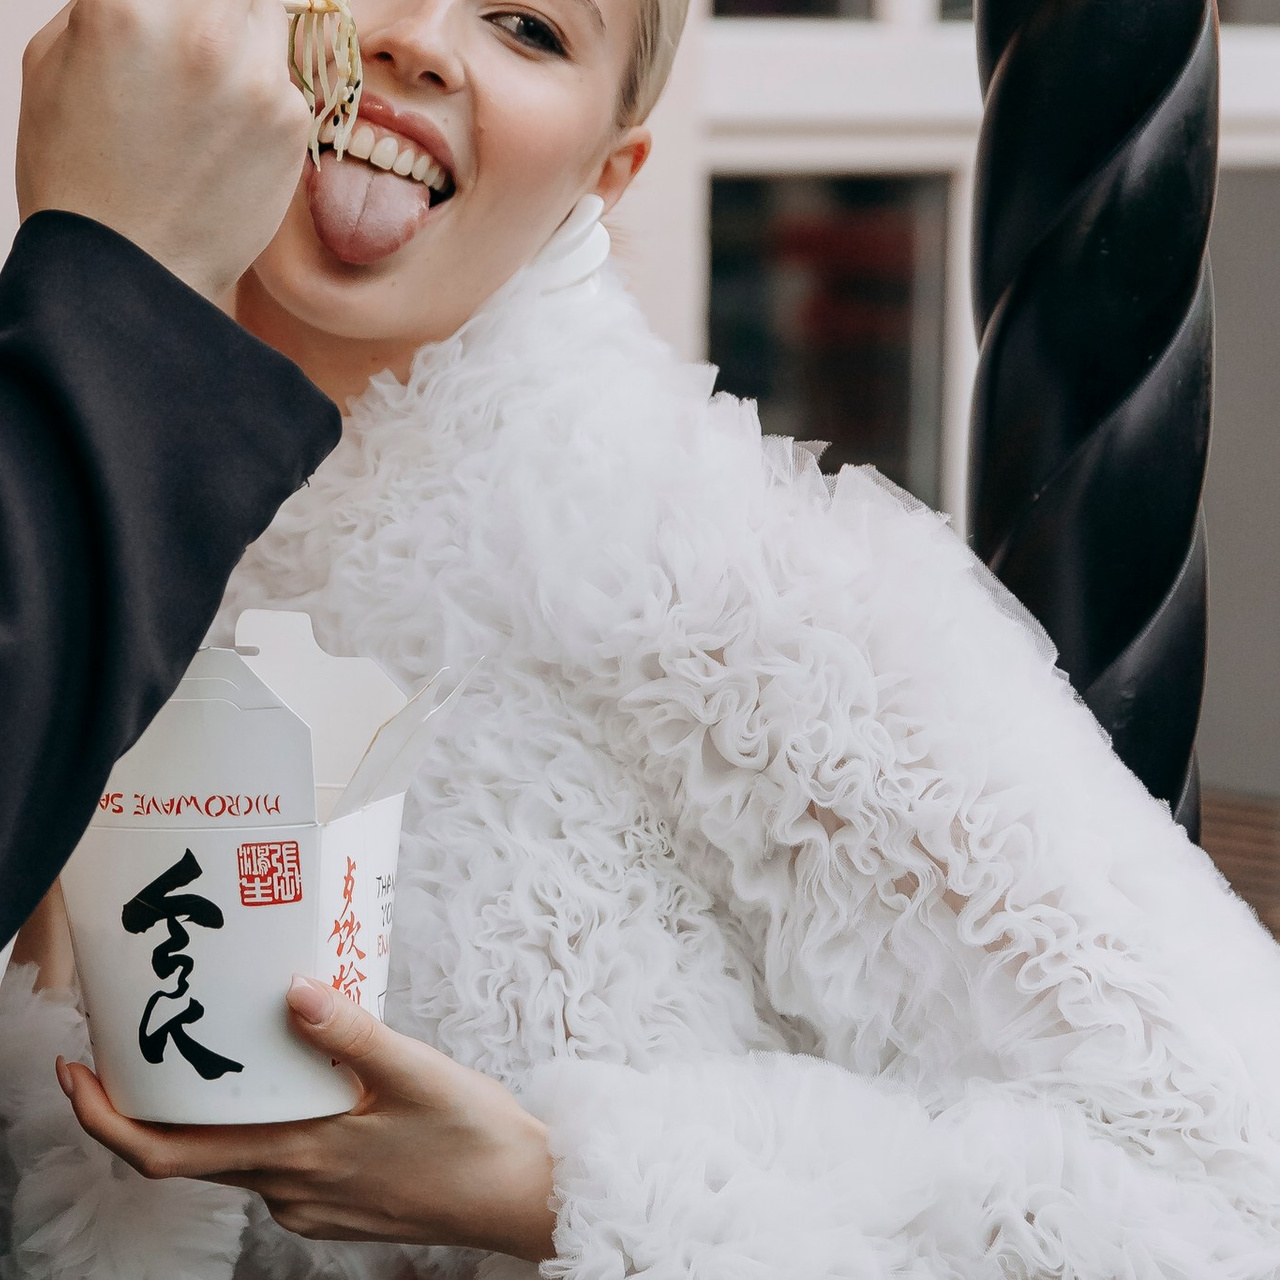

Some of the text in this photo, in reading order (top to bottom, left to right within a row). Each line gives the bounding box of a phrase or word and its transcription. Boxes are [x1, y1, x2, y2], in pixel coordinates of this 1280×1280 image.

[98, 793, 281, 817] MICROWAVE SA
[381, 902, 393, 927] YO
